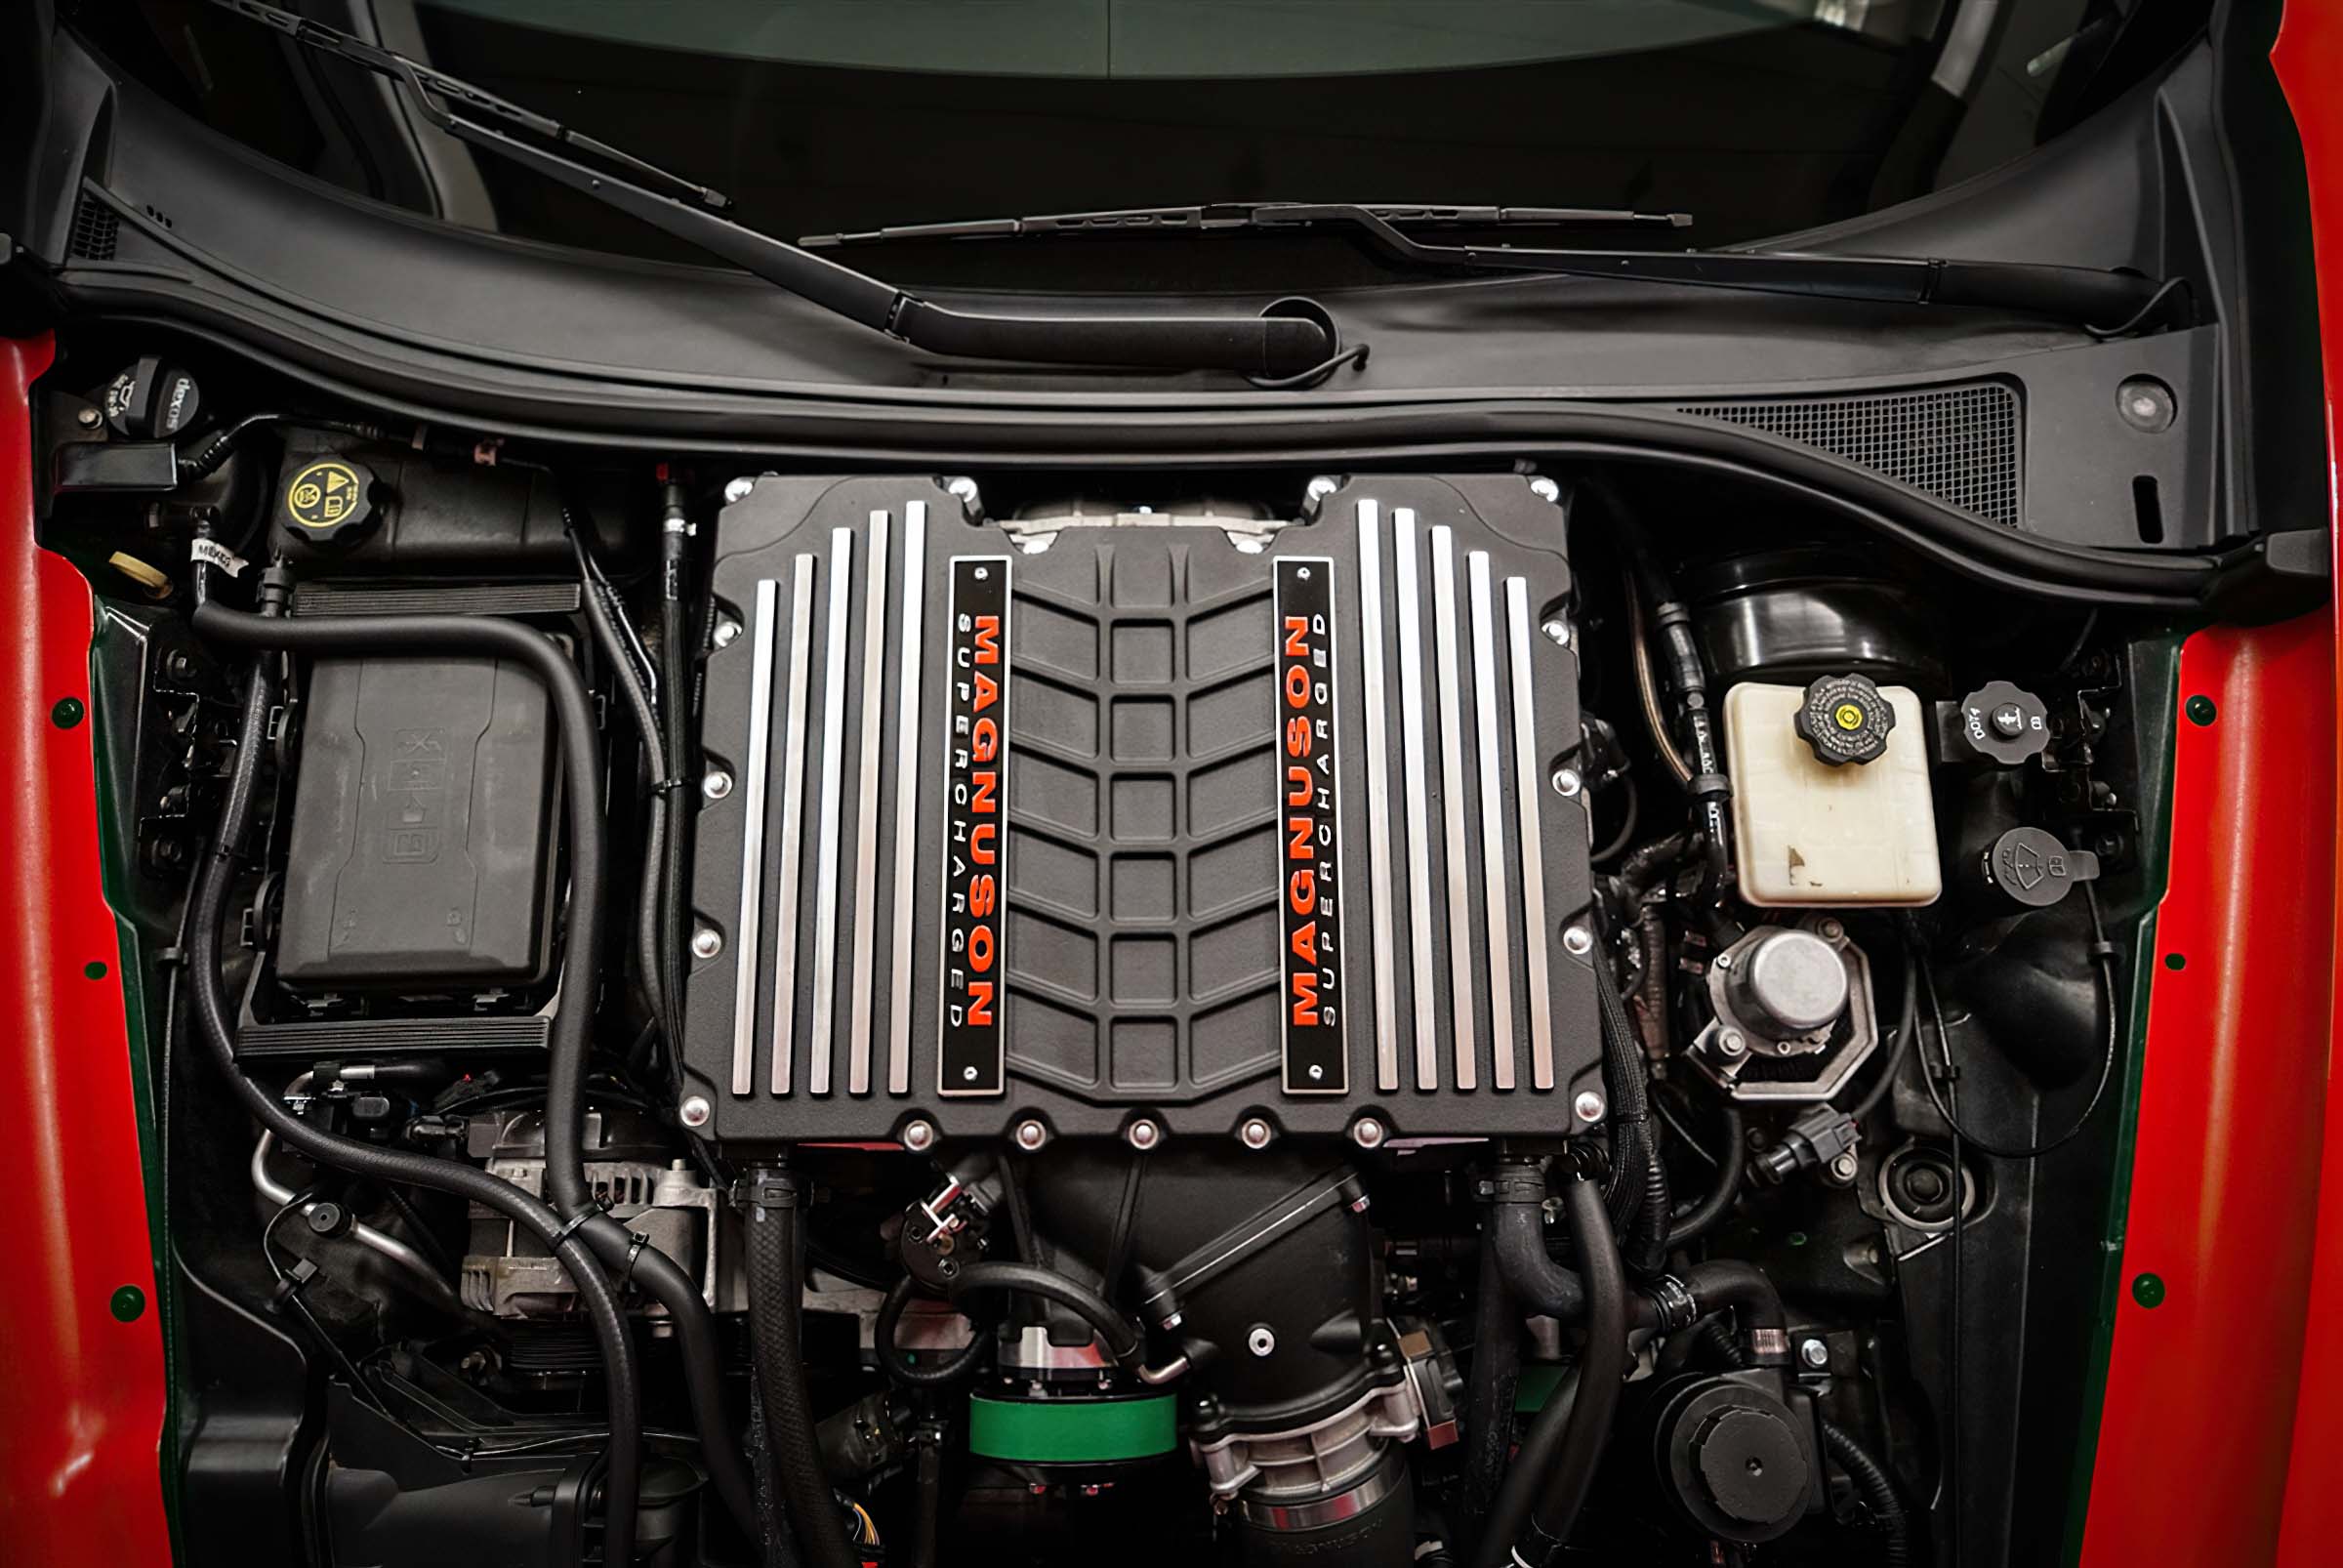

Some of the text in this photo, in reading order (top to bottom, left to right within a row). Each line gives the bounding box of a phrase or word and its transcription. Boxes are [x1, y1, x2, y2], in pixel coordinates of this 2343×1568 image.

[166, 377, 191, 431] dexos
[948, 612, 972, 1028] SUPERCHARGED
[966, 615, 1001, 1026] MAGNUSON
[1284, 615, 1319, 1026] MAGNUSON
[1311, 612, 1337, 1028] SUPERCHARGED
